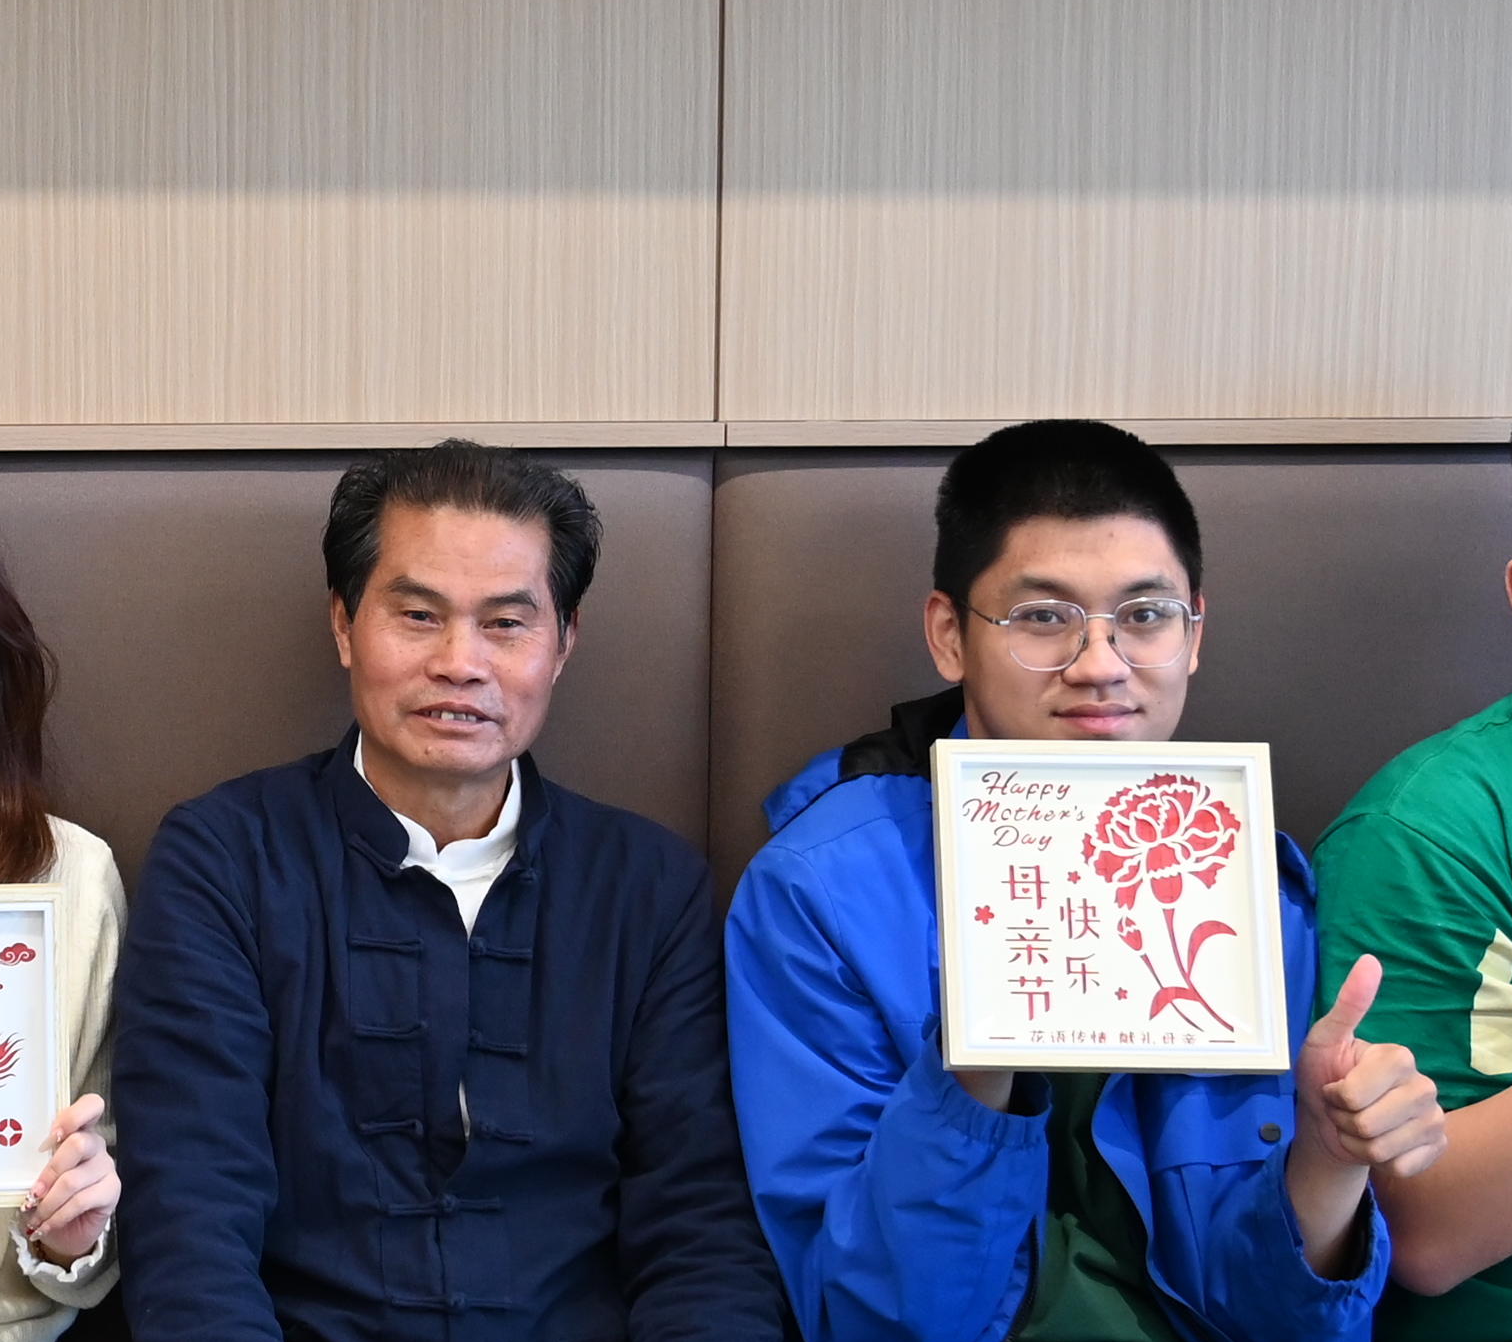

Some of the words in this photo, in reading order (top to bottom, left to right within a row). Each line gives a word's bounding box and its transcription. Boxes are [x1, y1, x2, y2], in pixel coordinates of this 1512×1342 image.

[982, 771, 1070, 799] Happy
[992, 825, 1052, 850] Day
[1001, 865, 1054, 1021] 母亲节
[1060, 898, 1100, 994] 快乐
